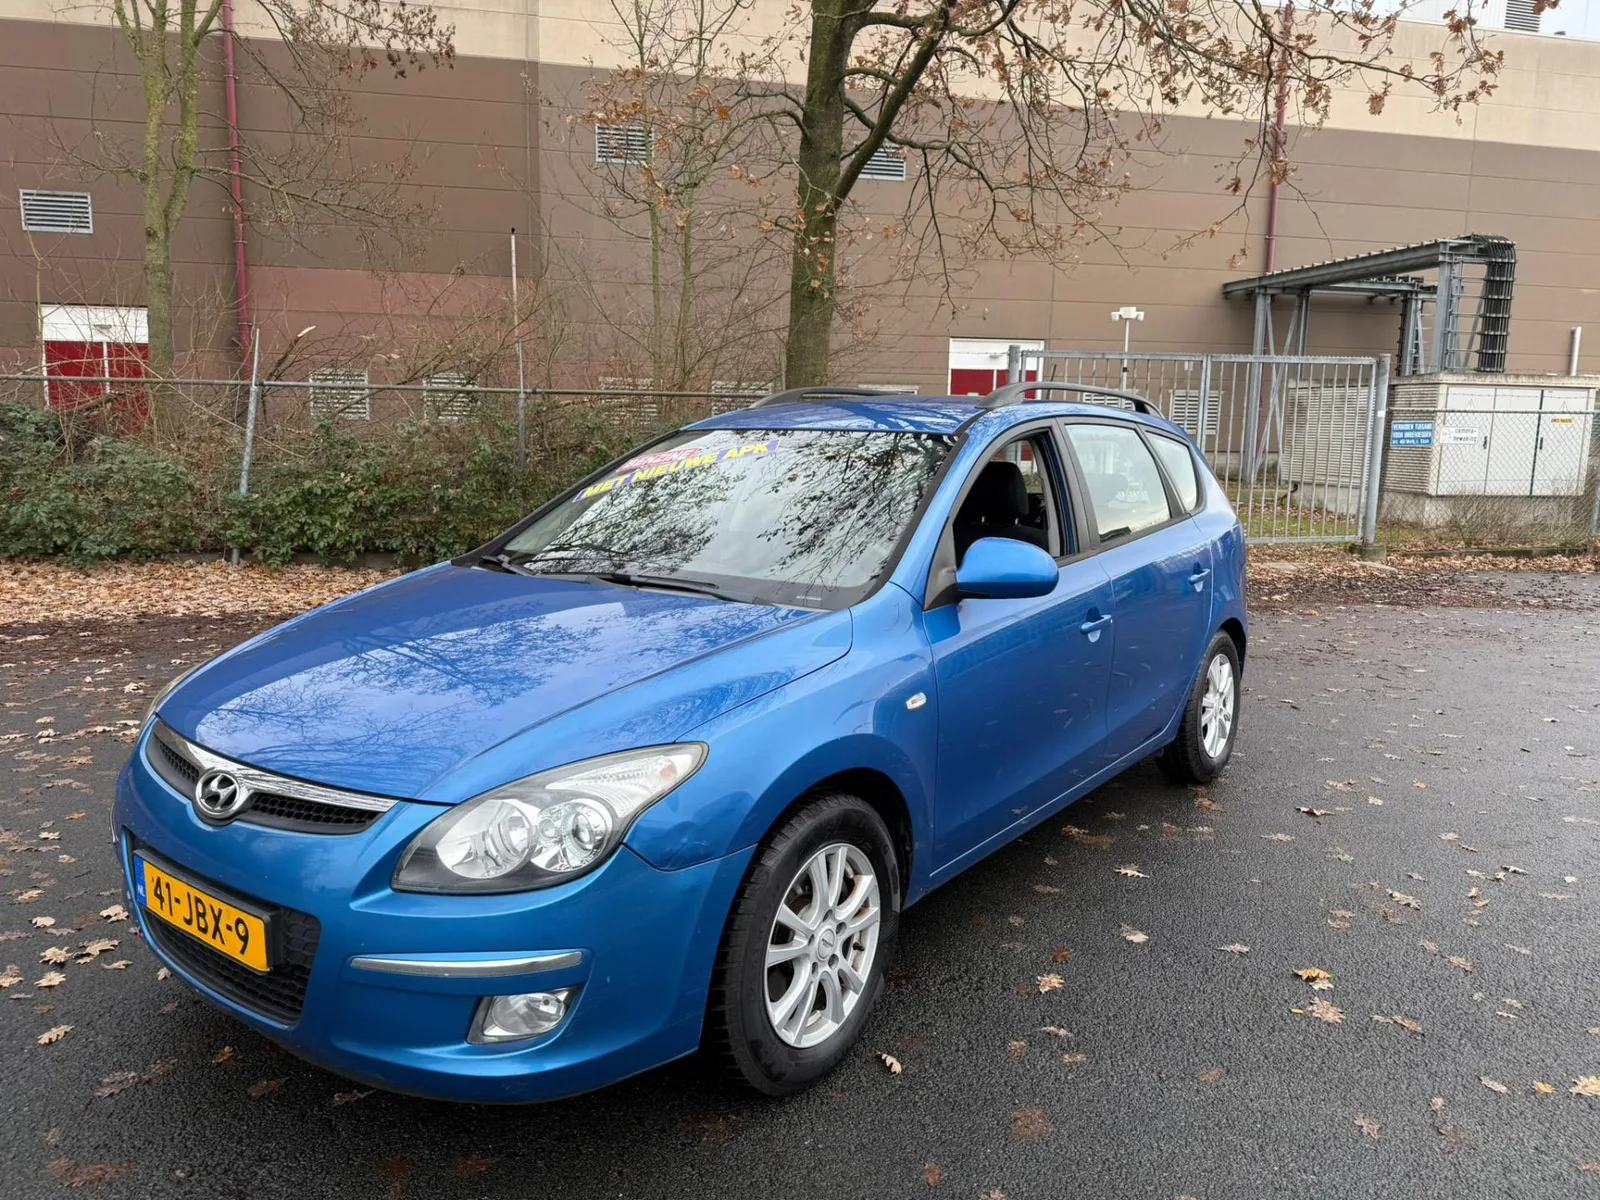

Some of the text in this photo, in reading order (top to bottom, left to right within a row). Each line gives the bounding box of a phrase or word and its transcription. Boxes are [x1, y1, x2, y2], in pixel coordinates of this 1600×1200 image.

[583, 443, 769, 498] MET NIEUWE APK
[625, 448, 698, 469] BENZINE
[153, 876, 250, 955] 41-JBX-9
